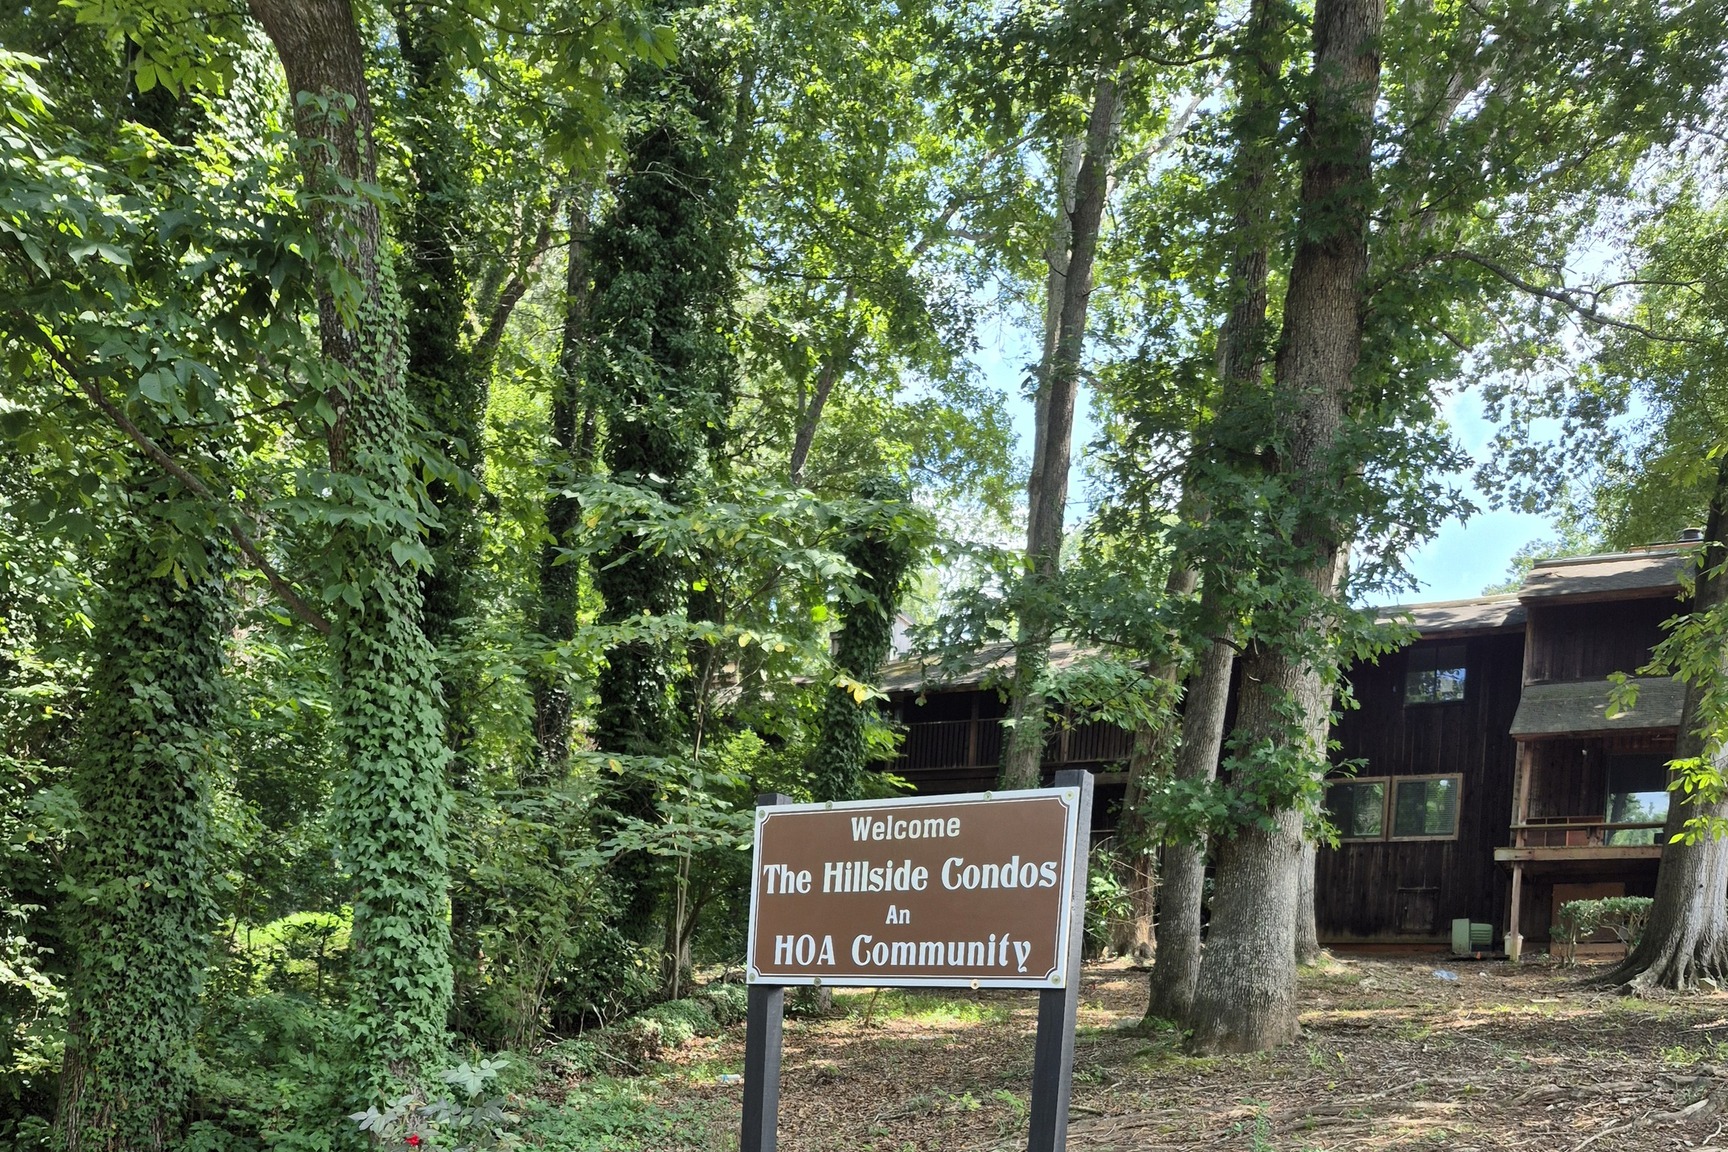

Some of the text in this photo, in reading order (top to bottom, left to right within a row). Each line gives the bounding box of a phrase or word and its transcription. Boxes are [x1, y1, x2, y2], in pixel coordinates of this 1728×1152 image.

[851, 814, 961, 842] Welcome
[763, 855, 1058, 895] The Hillside Condos
[885, 904, 911, 925] An
[774, 932, 1032, 973] HOA Community
